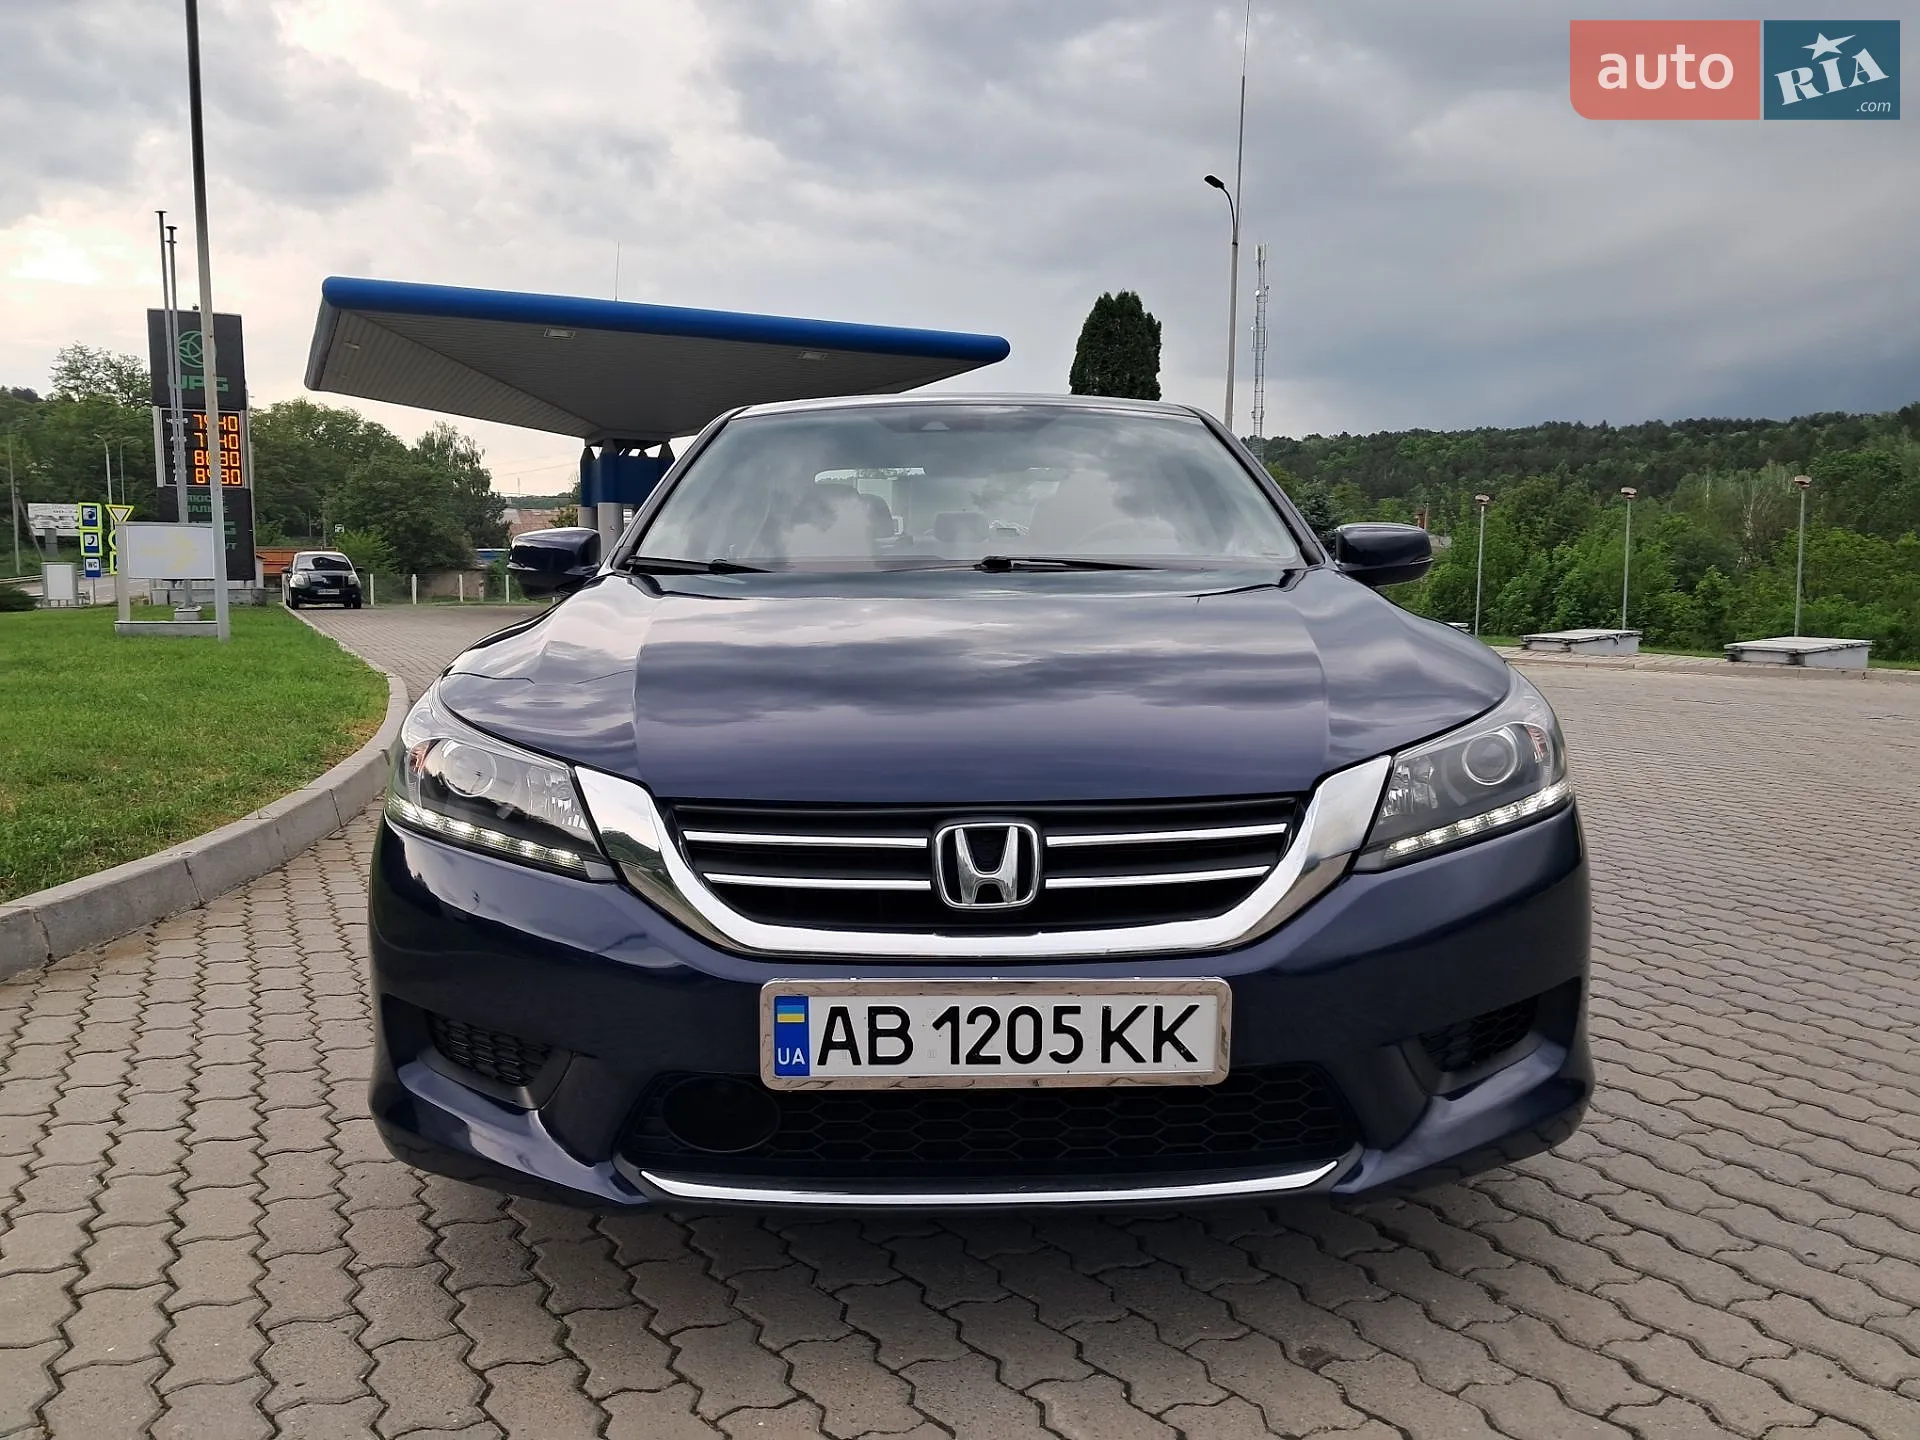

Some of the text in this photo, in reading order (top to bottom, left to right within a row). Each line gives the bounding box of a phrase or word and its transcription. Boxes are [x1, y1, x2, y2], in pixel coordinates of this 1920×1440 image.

[193, 432, 240, 449] 740
[87, 561, 98, 569] WC
[816, 1004, 1201, 1066] AB 1205 KK
[777, 1047, 806, 1066] UA
